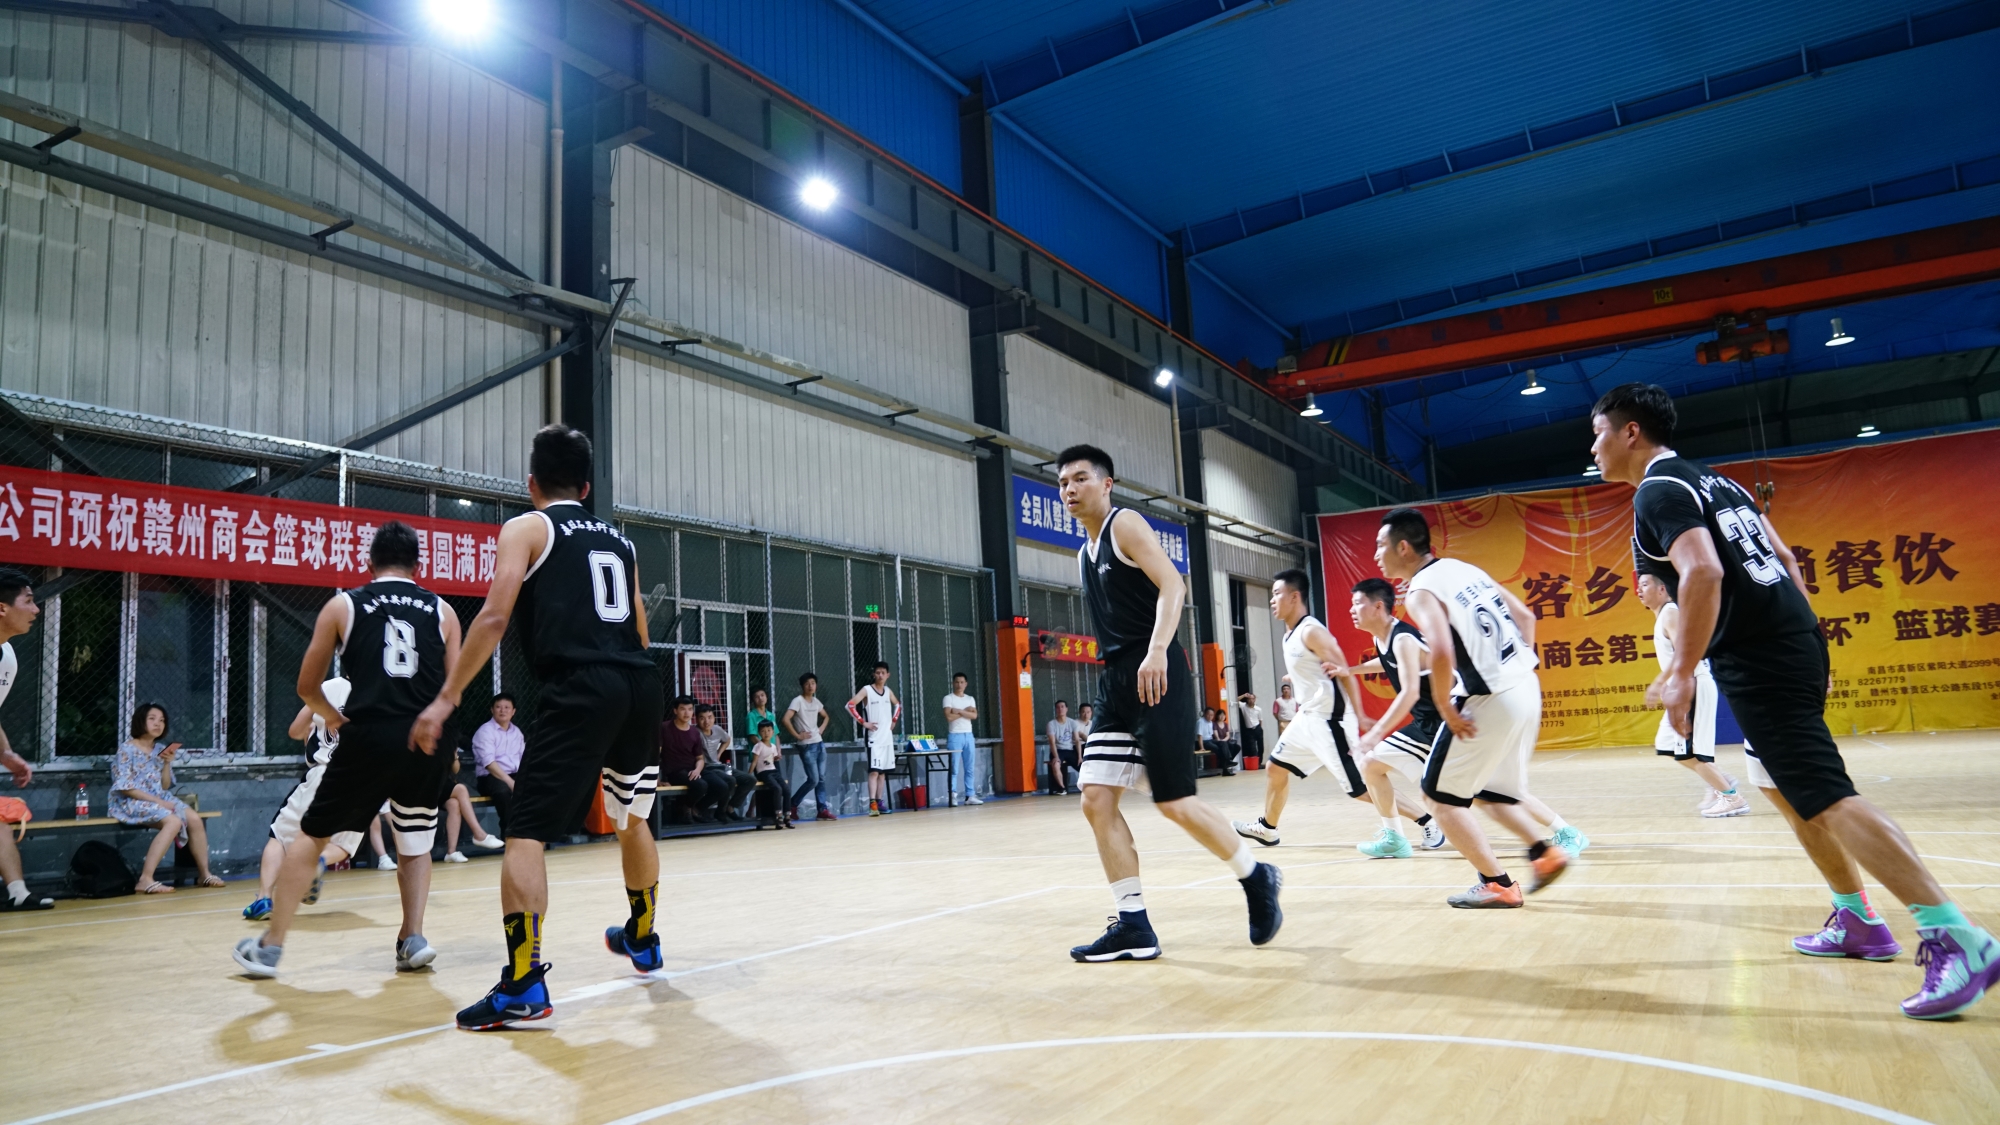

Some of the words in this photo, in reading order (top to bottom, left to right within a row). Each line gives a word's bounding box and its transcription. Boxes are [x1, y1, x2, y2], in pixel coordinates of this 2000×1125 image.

[1716, 505, 1790, 586] 33
[588, 550, 630, 622] 0
[383, 614, 419, 679] 8
[1534, 633, 1658, 670] 商会第二
[1892, 602, 2000, 642] 篮球赛
[1854, 698, 1897, 708] 8397779
[1857, 676, 1906, 686] 82267779
